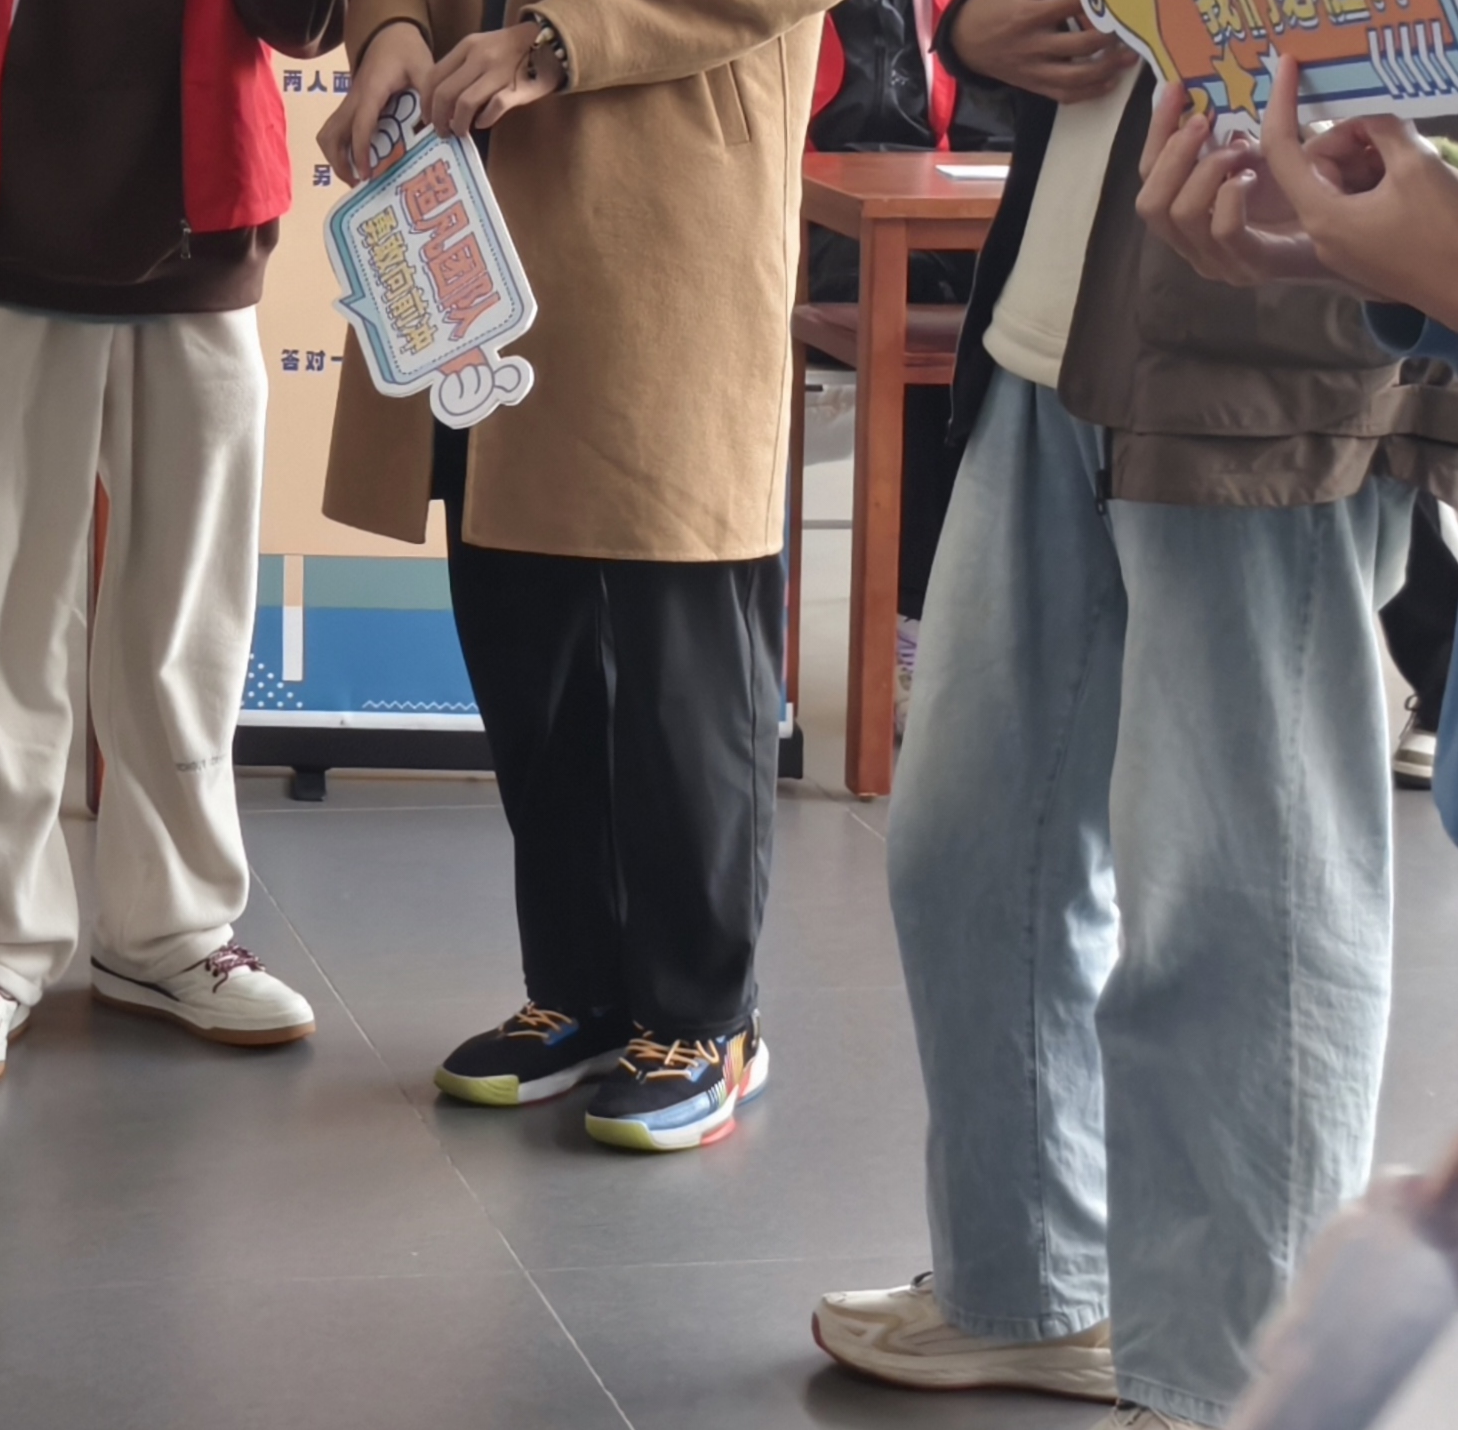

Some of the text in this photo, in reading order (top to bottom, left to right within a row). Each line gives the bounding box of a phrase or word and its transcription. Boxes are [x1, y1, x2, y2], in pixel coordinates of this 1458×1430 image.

[357, 205, 438, 355] 勇敢向前冲
[395, 158, 501, 342] 超凡团队
